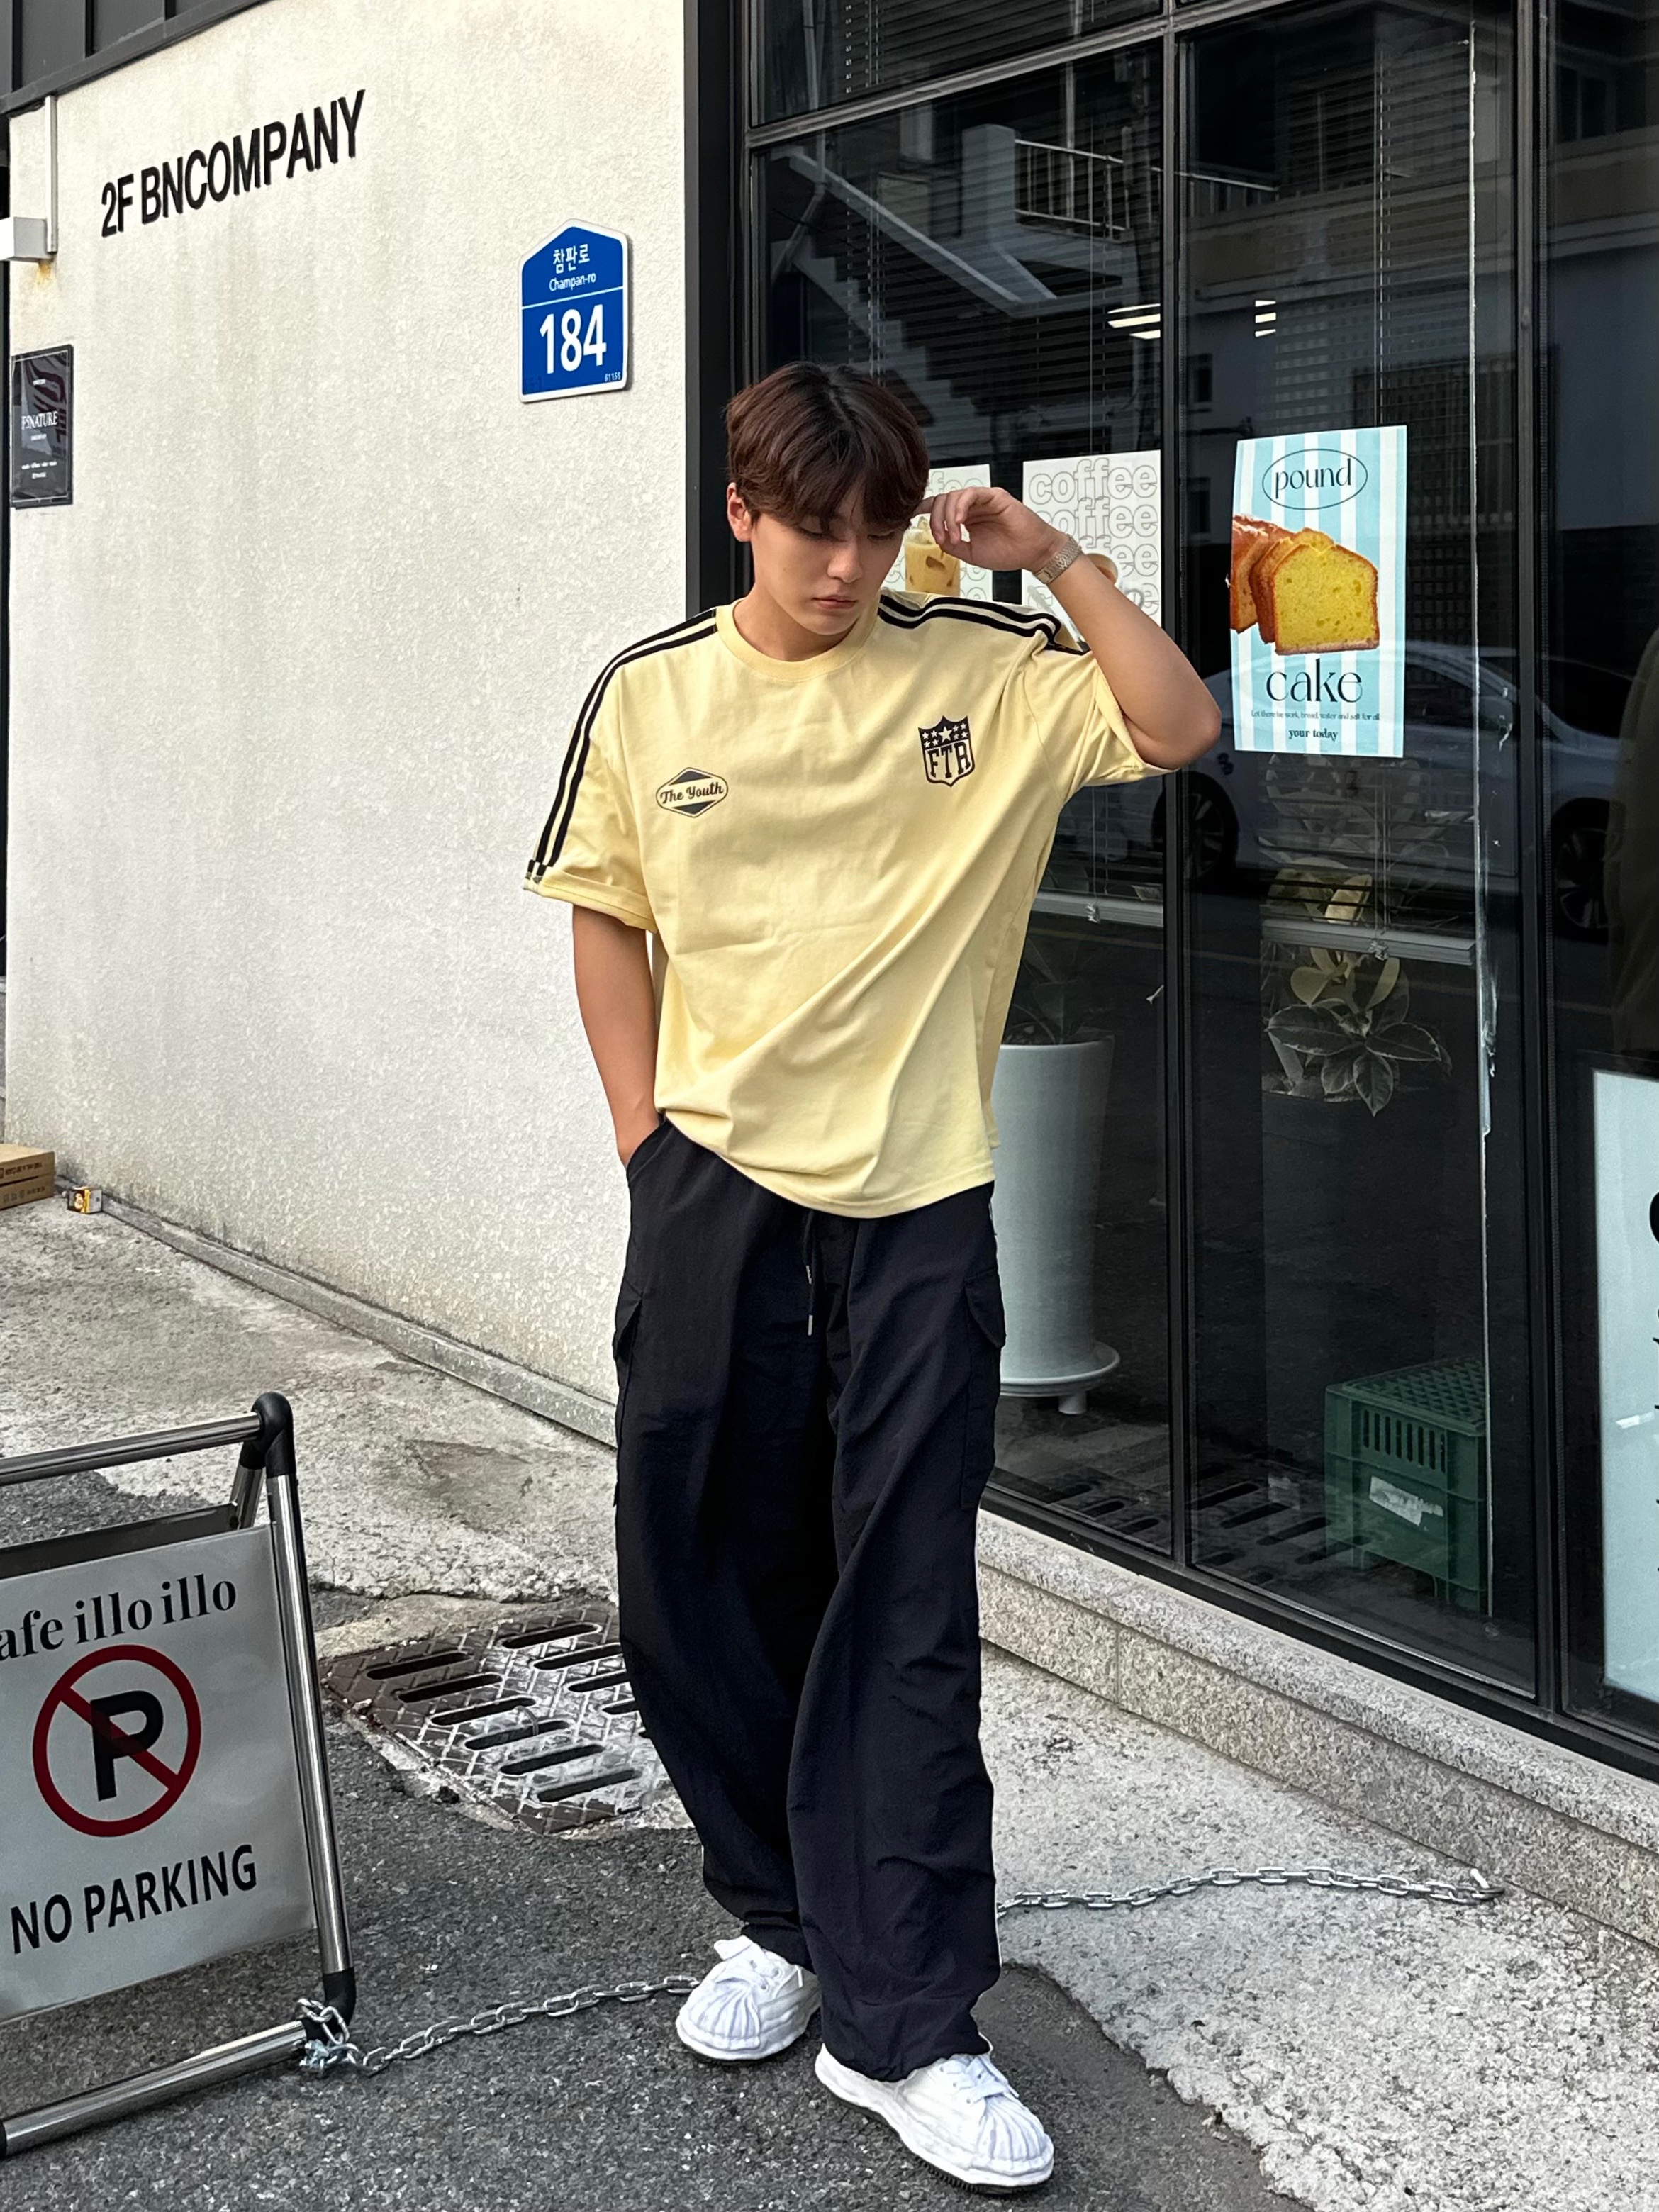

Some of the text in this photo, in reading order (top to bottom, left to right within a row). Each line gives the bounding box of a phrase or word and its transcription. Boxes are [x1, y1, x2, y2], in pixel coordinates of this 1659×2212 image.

[101, 89, 366, 238] 2F BNCOMPANY
[552, 243, 591, 274] 참판로
[549, 272, 597, 292] Champan-ro
[539, 303, 608, 374] 184
[1028, 457, 1158, 505] coffee
[1275, 457, 1352, 500] pound
[1266, 657, 1363, 703] cake
[1288, 727, 1338, 742] your today
[927, 741, 971, 779] FTR
[659, 781, 725, 805] The Youth
[74, 1592, 153, 1644] illo
[160, 1573, 237, 1625] illo
[11, 1844, 257, 1955] NO PARKING
